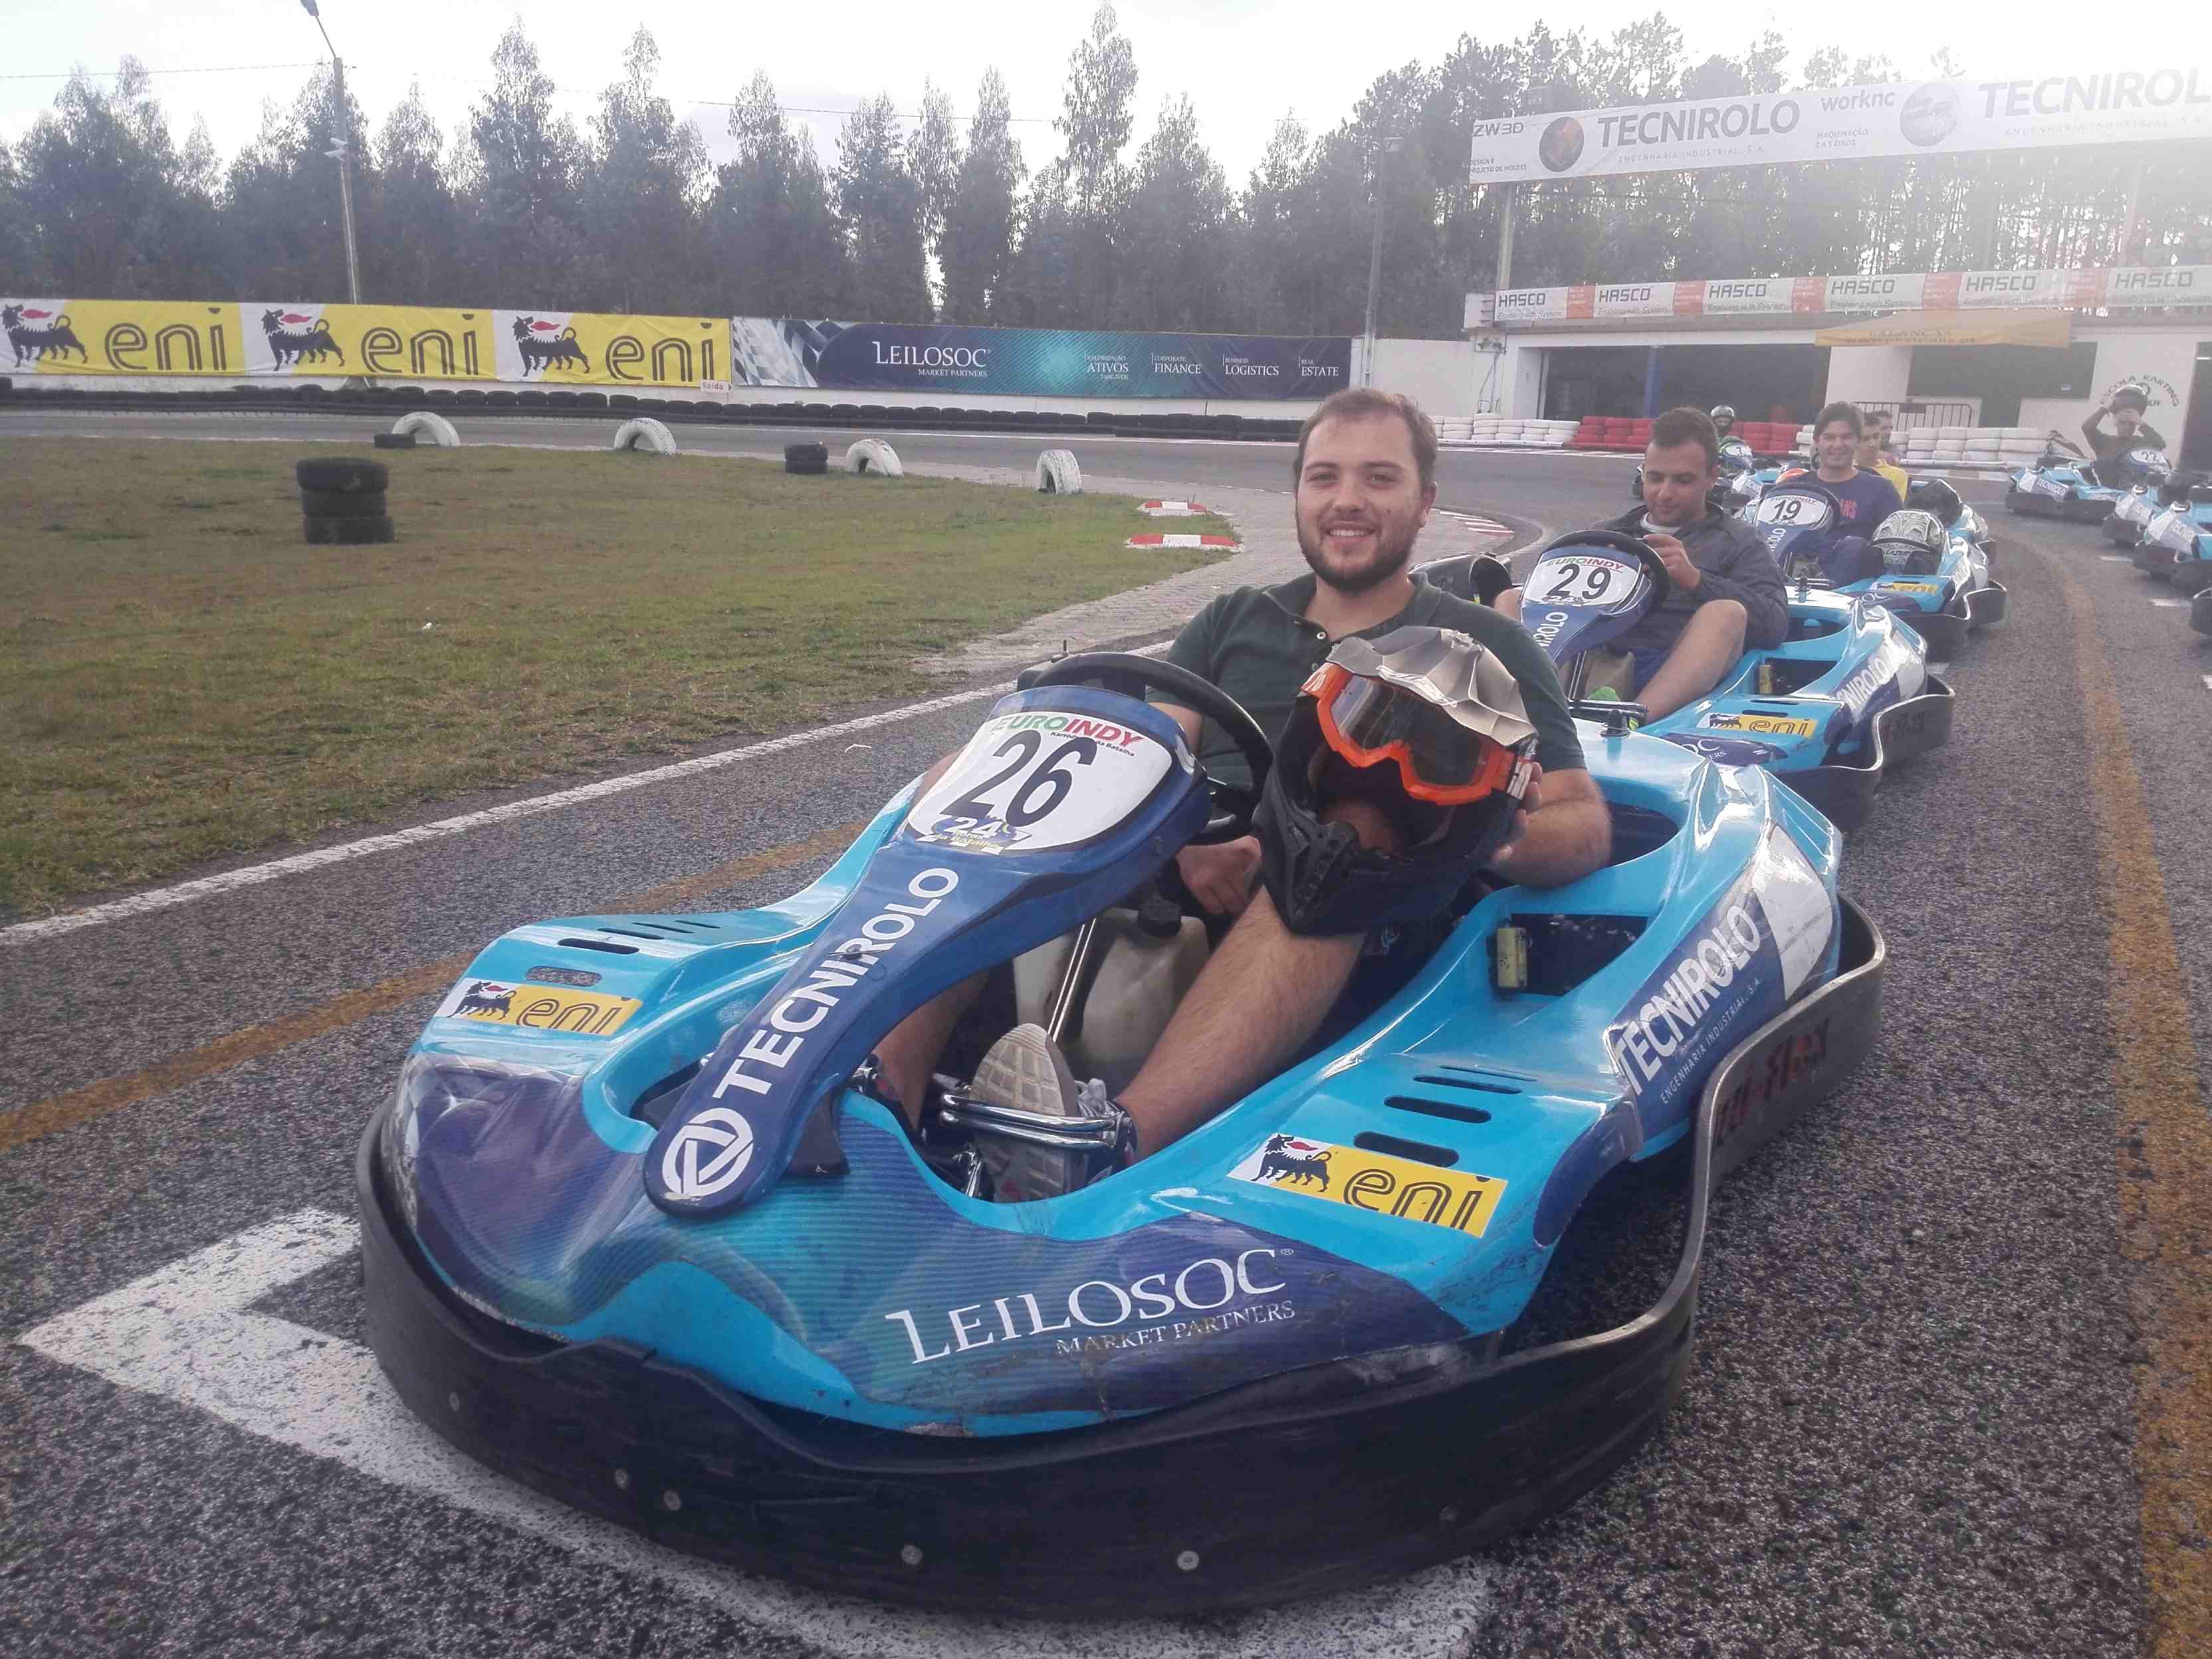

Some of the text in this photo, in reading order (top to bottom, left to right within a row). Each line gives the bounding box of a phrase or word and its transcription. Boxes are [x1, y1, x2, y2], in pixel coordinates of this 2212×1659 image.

[1821, 89, 1895, 111] worknc
[1597, 99, 1800, 147] TECNIROLO
[1830, 279, 1895, 294] HASCO
[1966, 275, 2037, 291] HASCO
[2116, 271, 2193, 287] HASCO
[1499, 292, 1545, 307] HASCO
[1599, 288, 1650, 302] HASCO
[1709, 282, 1767, 298] HASCO
[104, 307, 227, 371] eni
[361, 313, 479, 376] eni
[606, 322, 715, 382] eni
[1087, 363, 1129, 373] ATIVOS
[1155, 363, 1201, 374] FINANCE
[1225, 365, 1279, 376] LOGISTICS
[1301, 366, 1339, 377] ESTATE
[2141, 451, 2159, 461] 22
[1771, 500, 1801, 522] 19
[1546, 558, 1624, 570] EUROINDY
[1547, 563, 1611, 600] 29
[990, 715, 1144, 747] EUROINDY
[1749, 719, 1809, 736] eni
[1106, 742, 1135, 757] Batalha
[940, 729, 1097, 828] 26
[943, 816, 1003, 837] 24
[713, 867, 959, 1099] TECNIROLO
[1614, 905, 1760, 1095] TECNIROLO
[516, 996, 632, 1034] eni
[1660, 1045, 1707, 1105] ENGENHARIA
[1344, 1168, 1490, 1230] eni
[1055, 1299, 1295, 1356] MARKET PARTNERS
